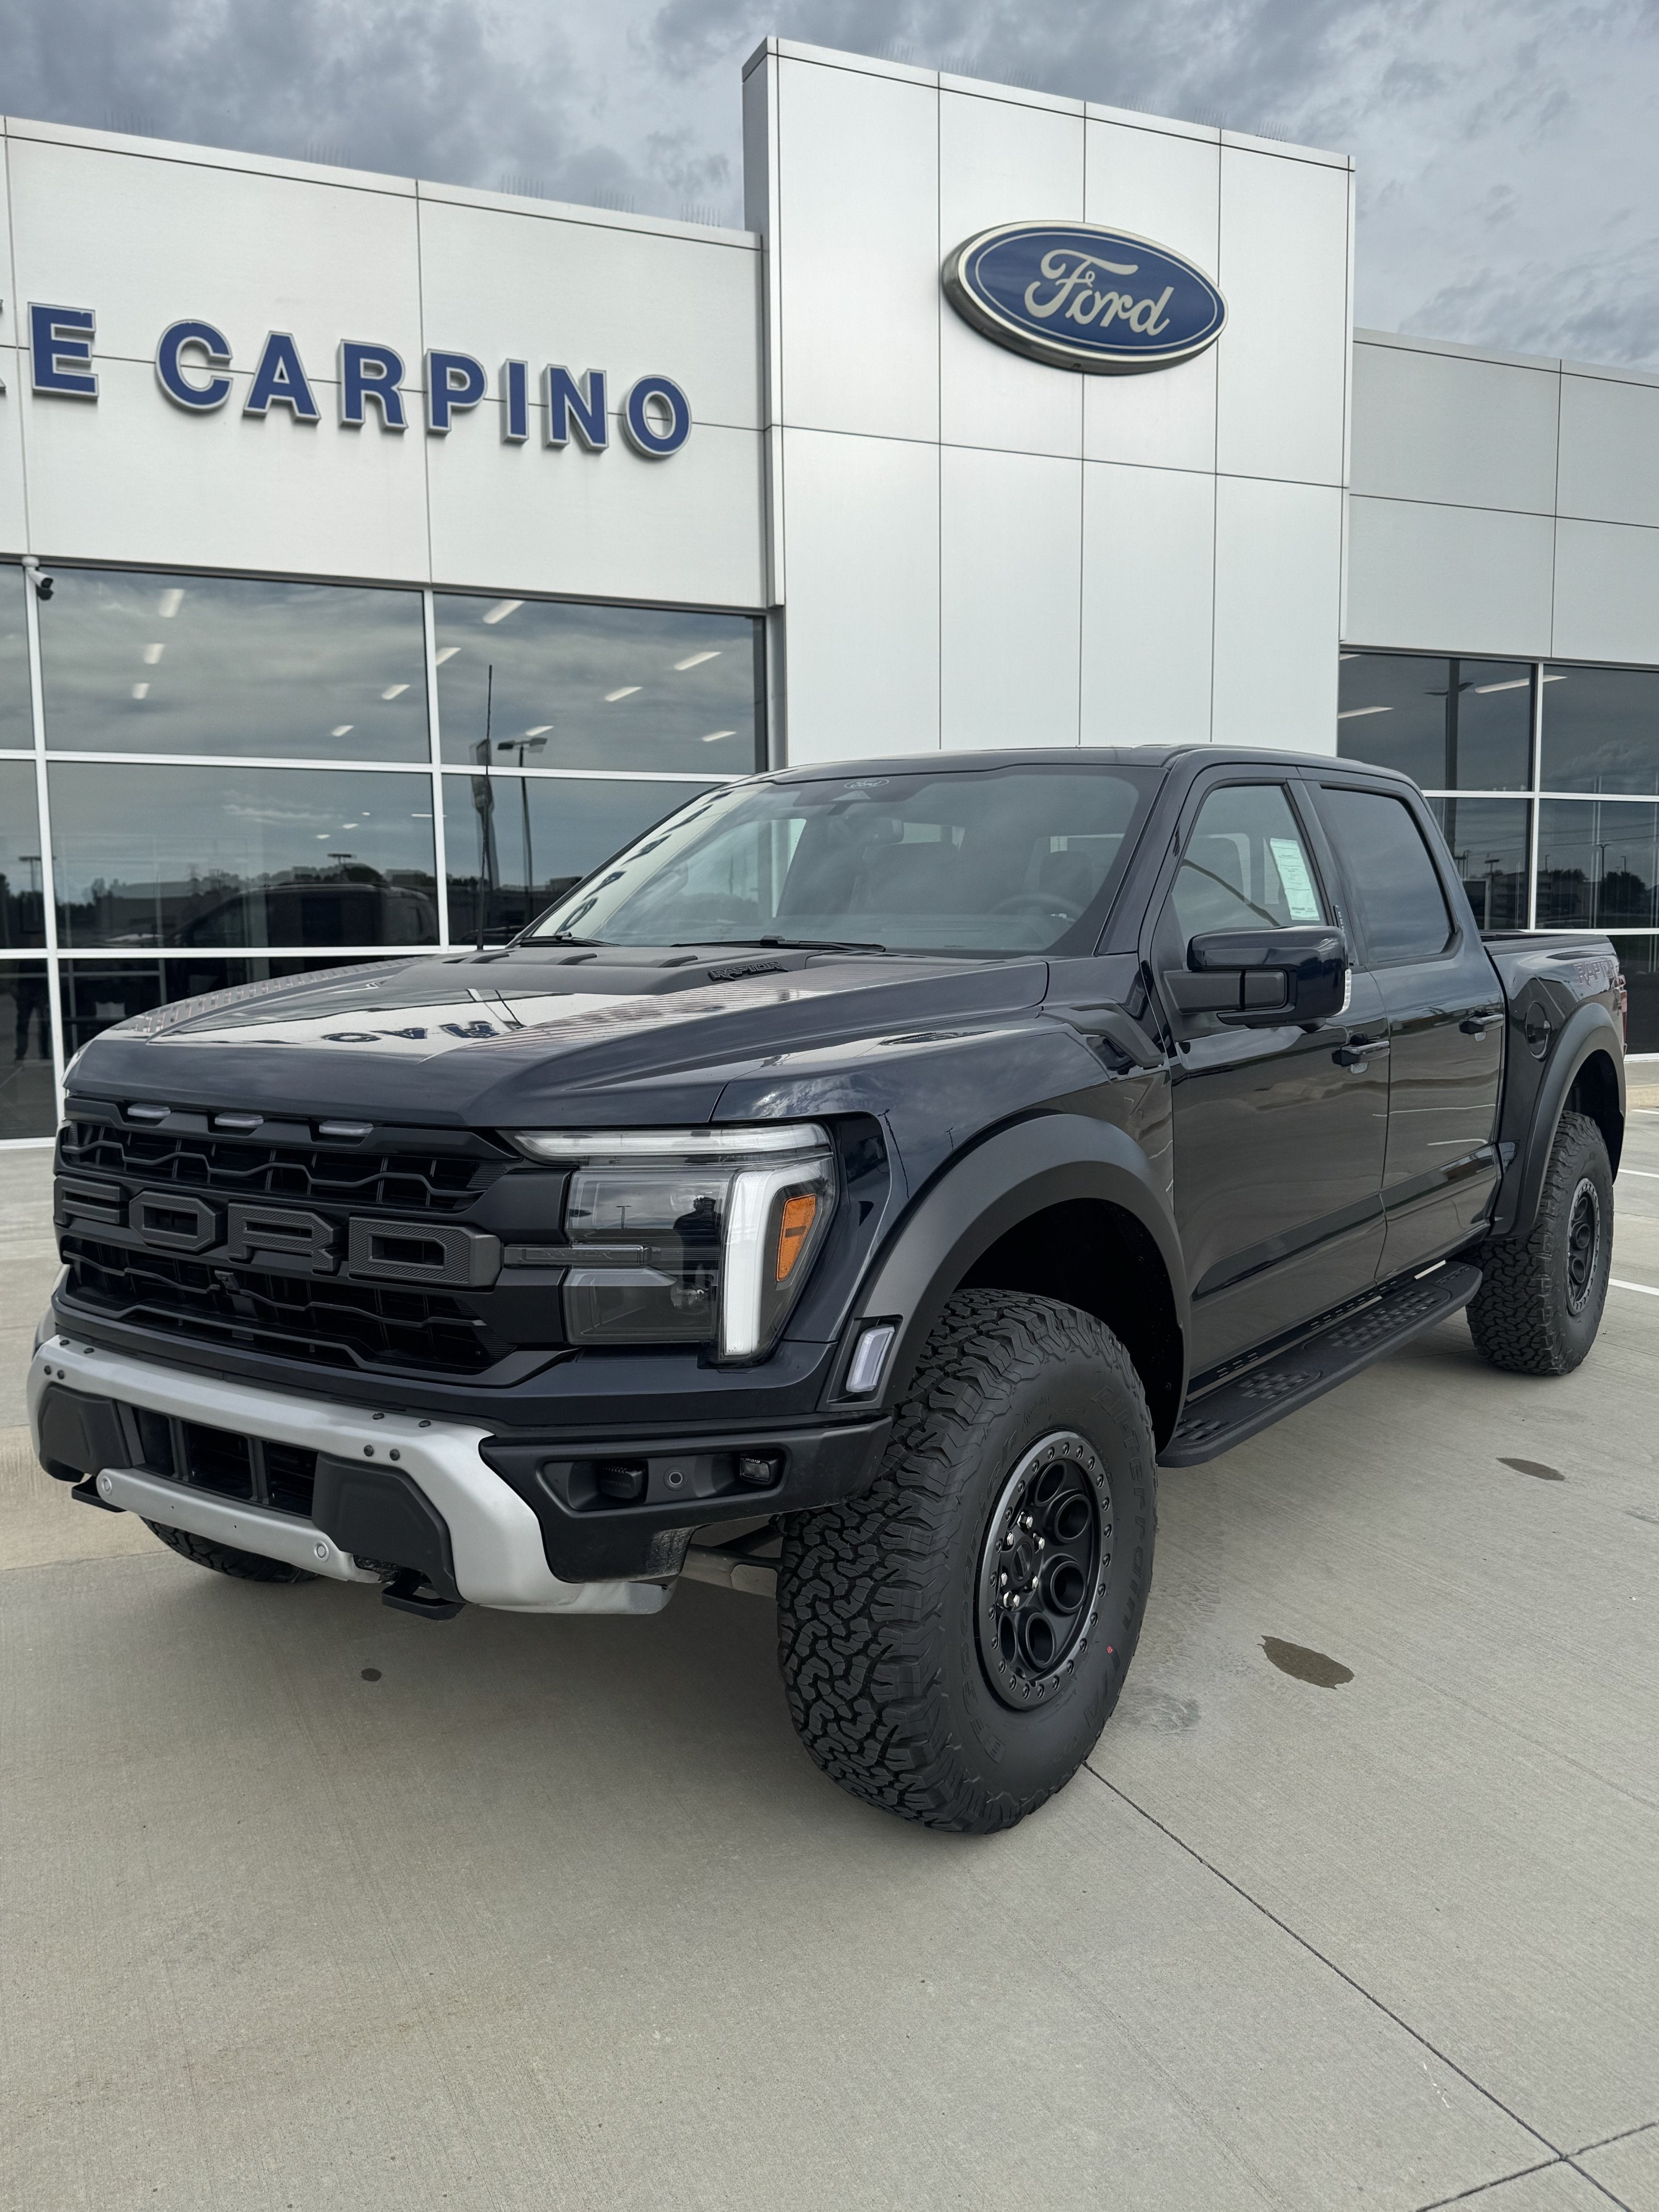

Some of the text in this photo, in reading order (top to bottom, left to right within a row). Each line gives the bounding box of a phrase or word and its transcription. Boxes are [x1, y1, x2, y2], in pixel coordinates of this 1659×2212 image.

[1024, 249, 1174, 335] Ford
[0, 299, 692, 458] E CARPINO
[709, 961, 789, 981] RAPTOR
[53, 1174, 499, 1289] FORD
